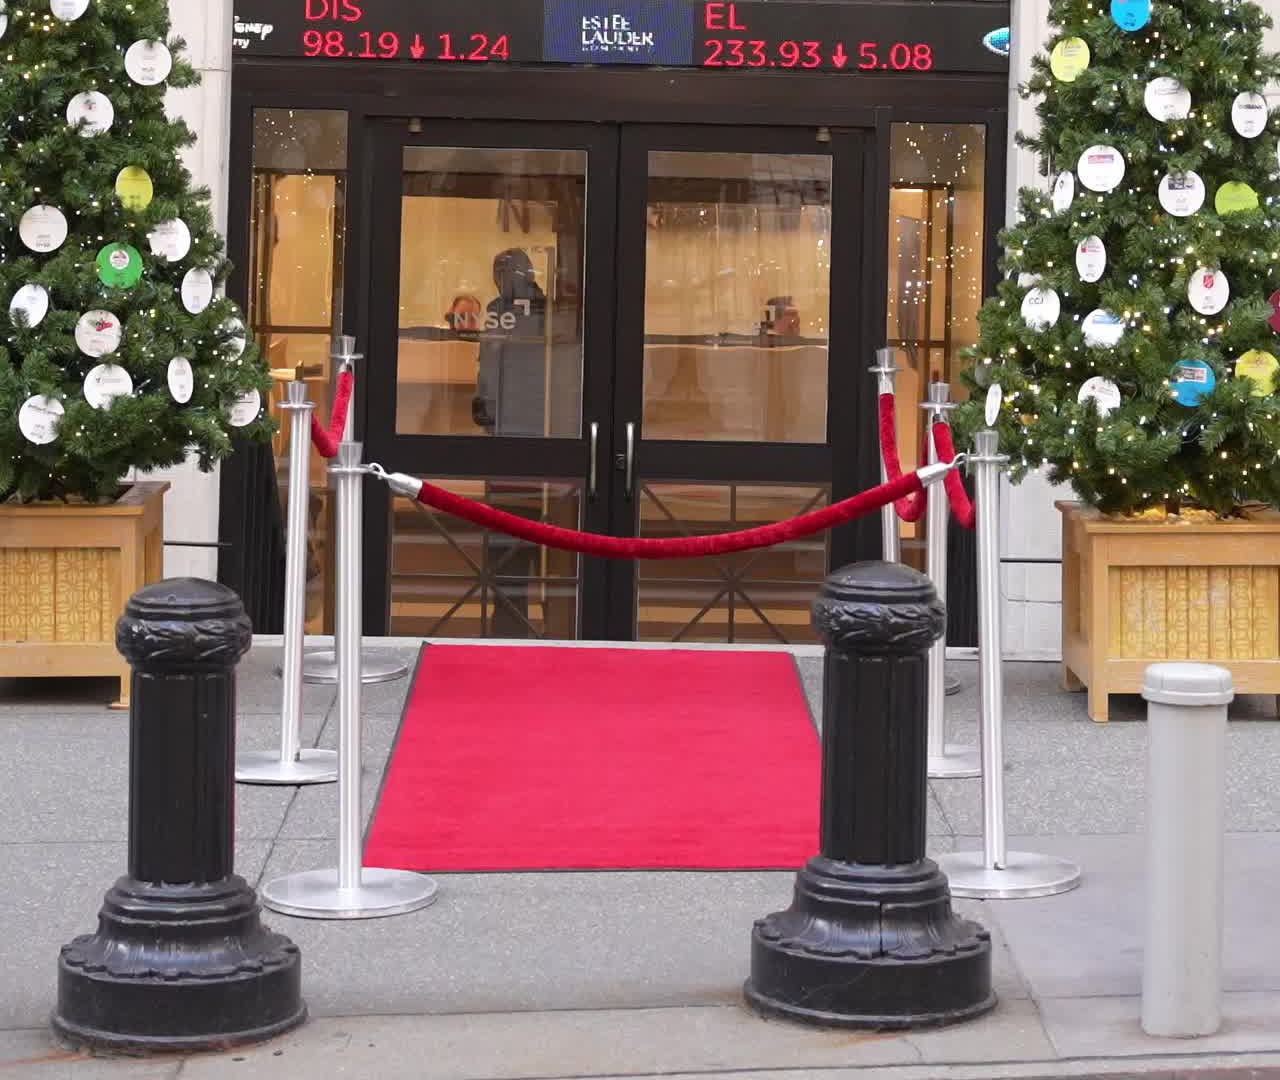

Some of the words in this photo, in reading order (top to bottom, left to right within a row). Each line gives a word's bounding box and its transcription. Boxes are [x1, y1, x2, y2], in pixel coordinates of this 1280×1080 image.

[705, 3, 746, 30] EL
[303, 30, 400, 58] 98.19
[437, 33, 511, 60] 1.24
[582, 30, 654, 46] LAUDER
[704, 39, 821, 68] 233.93
[858, 42, 933, 70] 5.08
